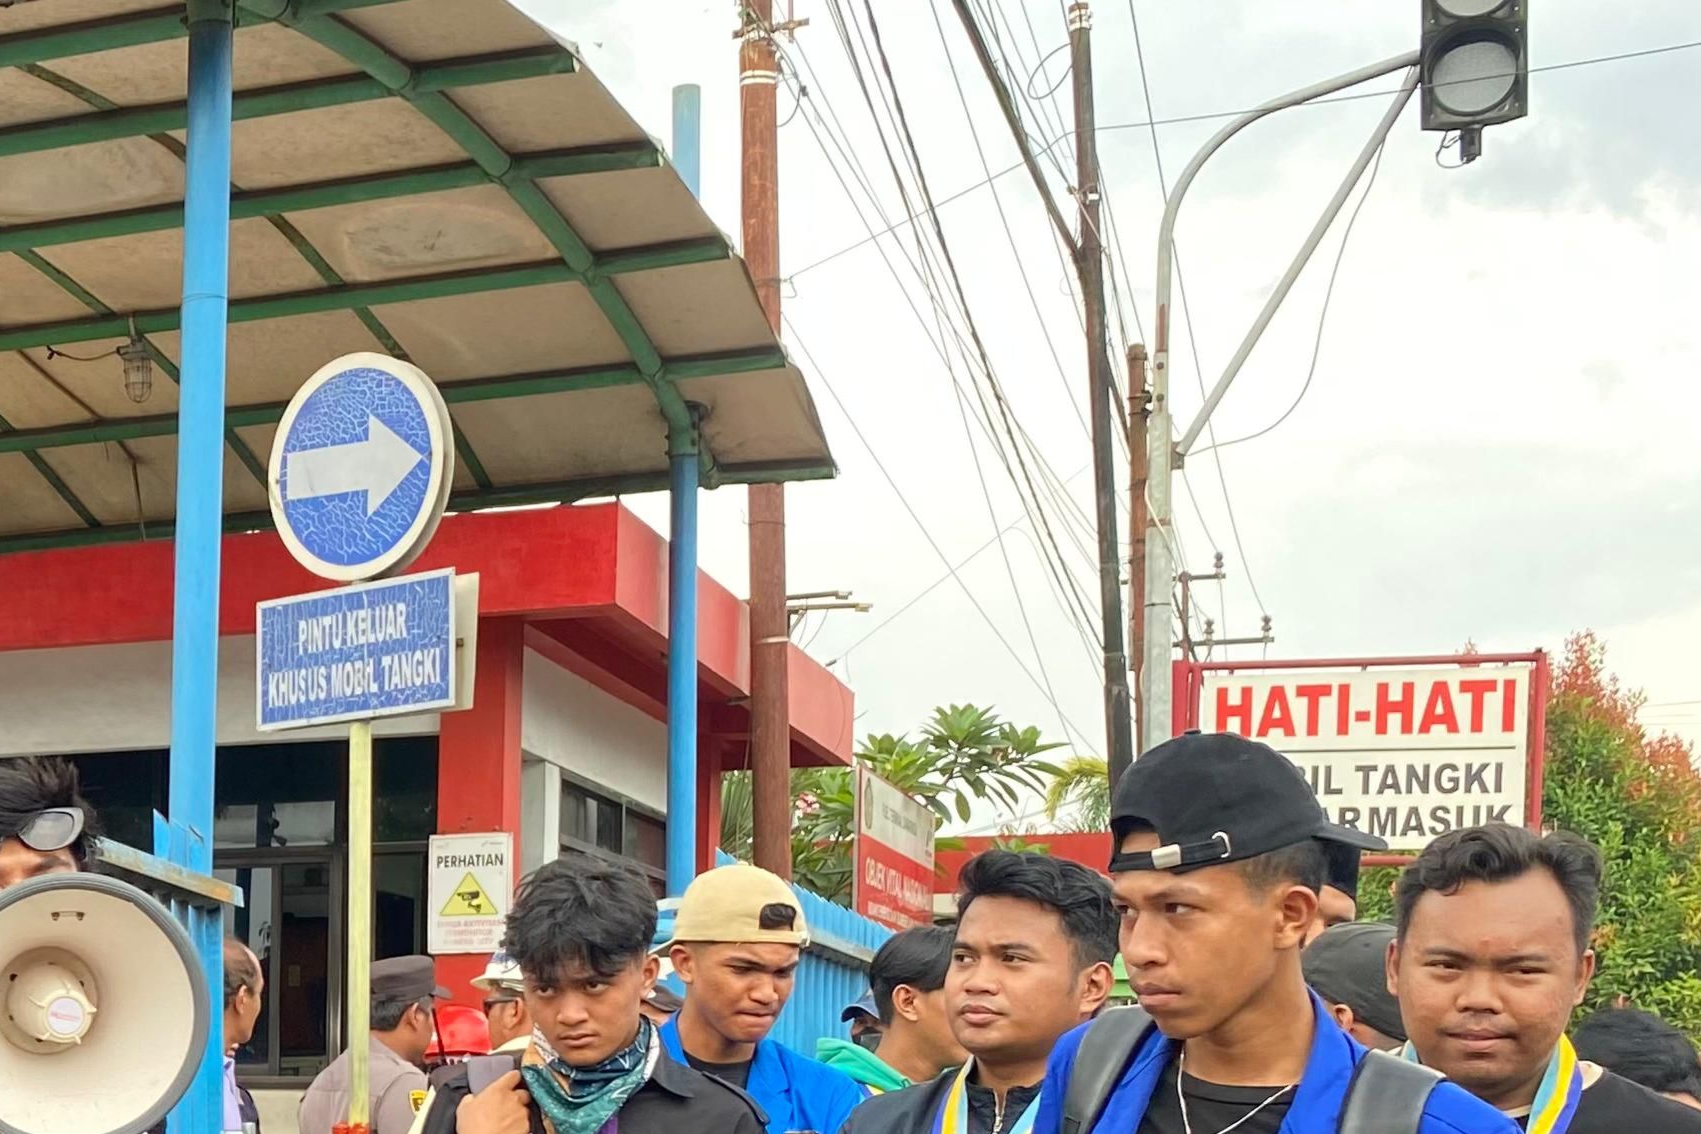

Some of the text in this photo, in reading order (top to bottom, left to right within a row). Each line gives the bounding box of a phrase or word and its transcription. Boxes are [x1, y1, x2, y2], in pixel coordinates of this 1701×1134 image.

[299, 602, 408, 656] PINTU KELUAR
[267, 647, 441, 709] KHUSUS MOBIL TANGKI
[1215, 678, 1517, 738] HATI-HATI
[1354, 761, 1504, 796] TANGKI
[436, 853, 504, 869] PERHATIAN
